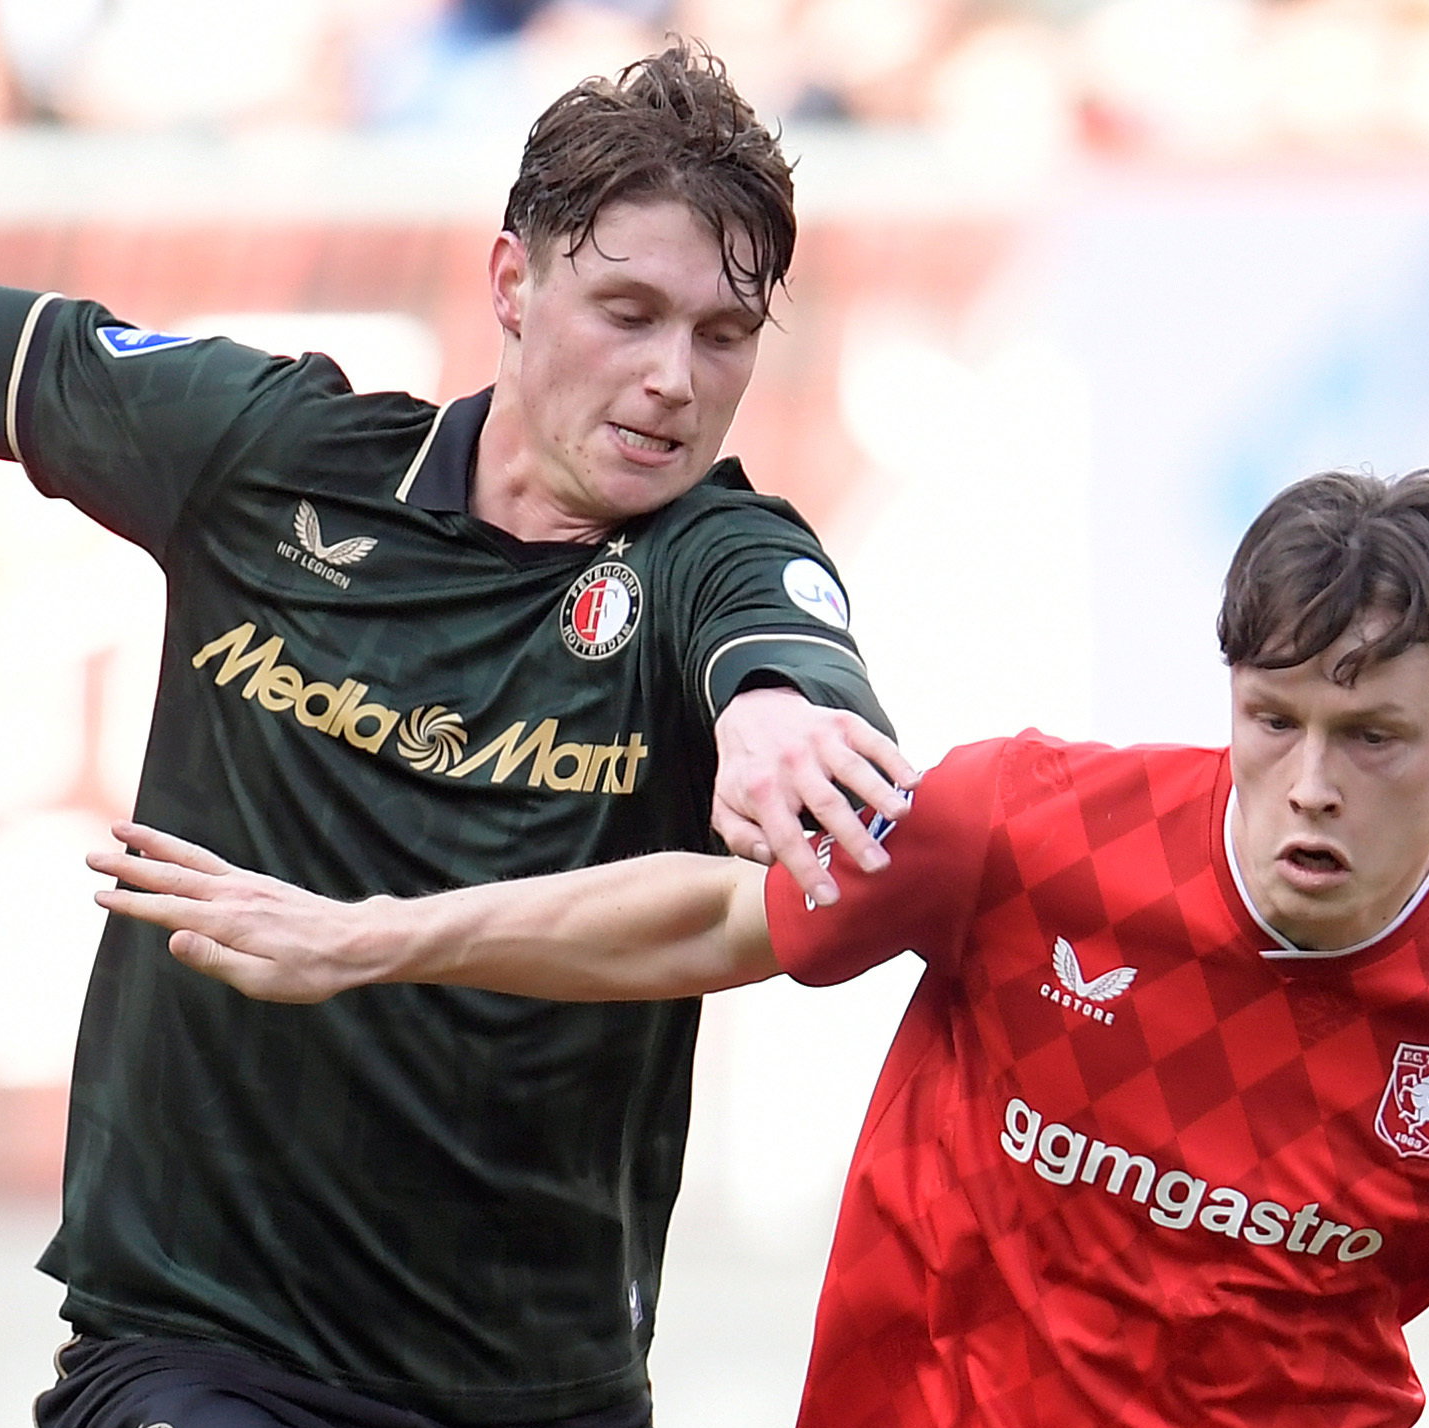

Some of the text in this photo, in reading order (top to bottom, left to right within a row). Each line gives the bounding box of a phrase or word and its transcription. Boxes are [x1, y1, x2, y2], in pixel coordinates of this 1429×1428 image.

[276, 541, 351, 589] HET LEGIOEN
[571, 566, 638, 598] FEYENOORD
[563, 624, 632, 656] ROTTERDAM
[1040, 983, 1115, 1026] CASTORE
[1000, 1098, 1383, 1262] ggmgastro
